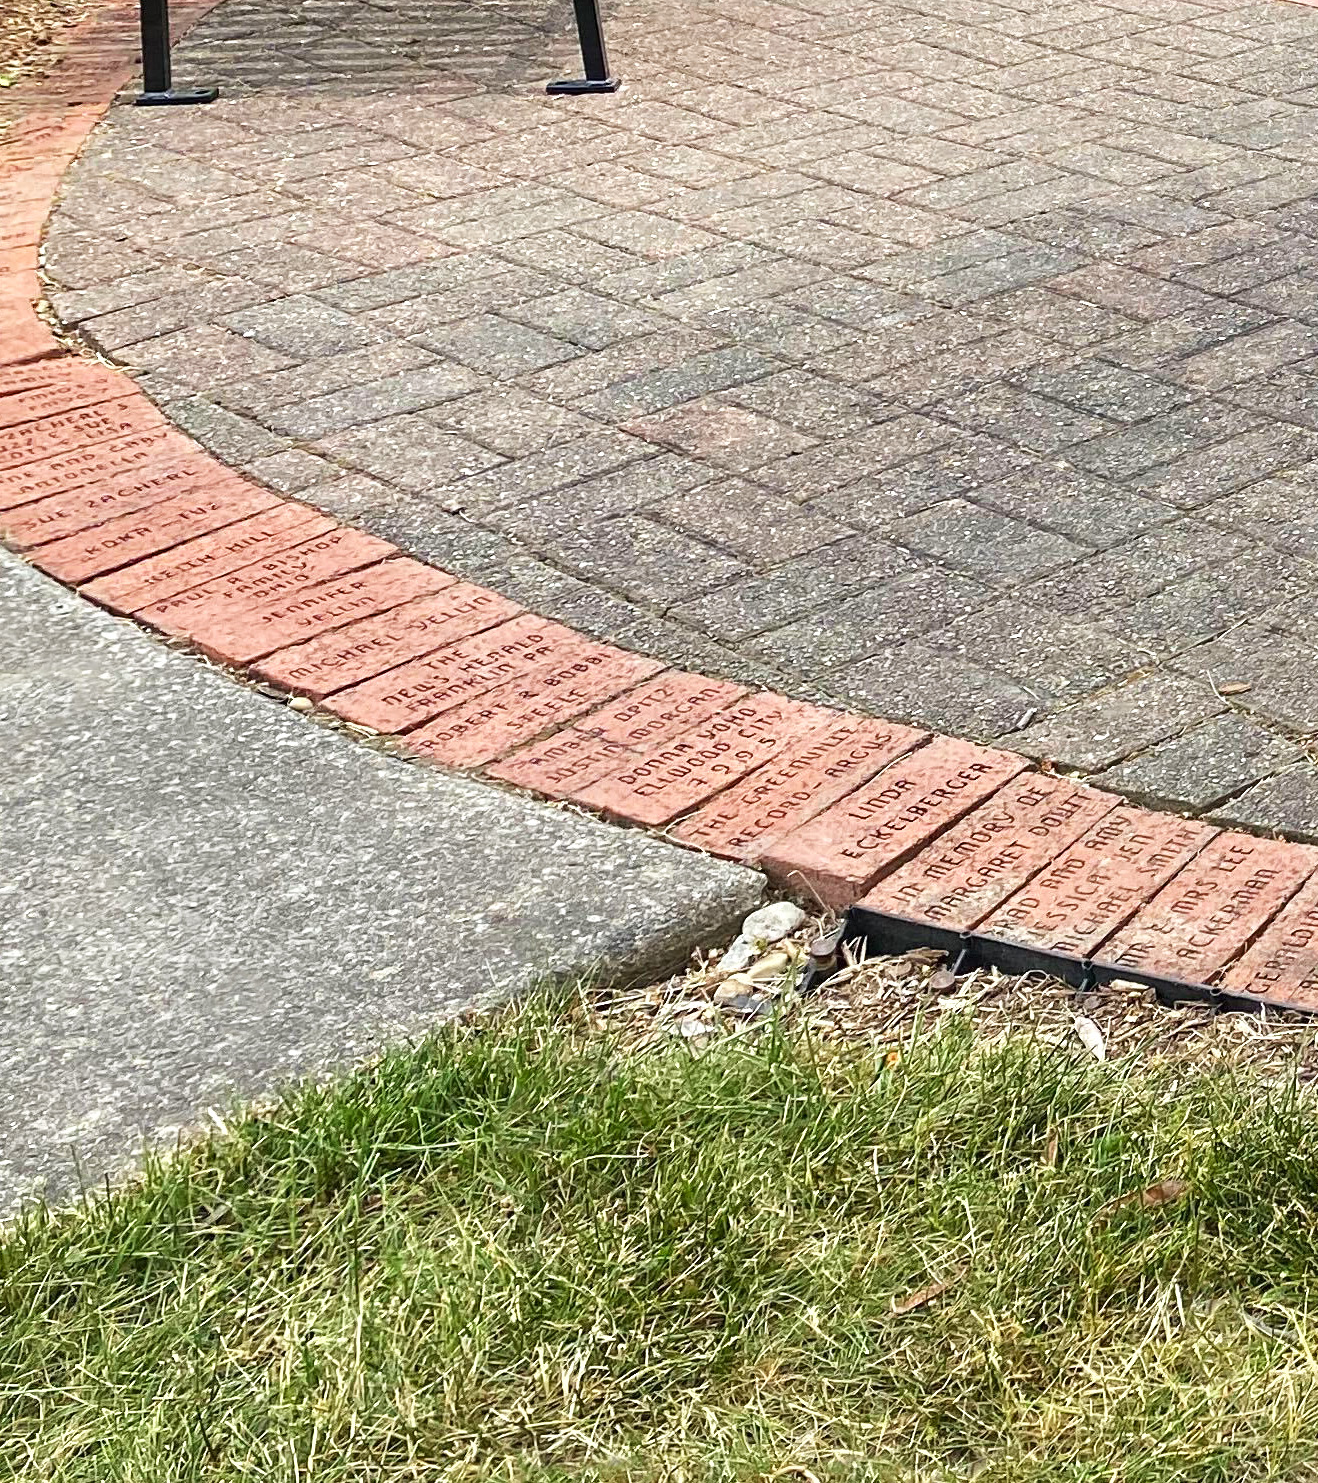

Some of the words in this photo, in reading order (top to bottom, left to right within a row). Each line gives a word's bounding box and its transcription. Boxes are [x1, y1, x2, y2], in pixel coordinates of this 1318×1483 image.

[156, 587, 218, 614] PAUL
[261, 535, 343, 572] BISHOP
[226, 530, 275, 554] HILL
[222, 560, 309, 600] FAMILY
[261, 581, 368, 623] JENNIFER
[297, 595, 376, 627] YELLIN
[288, 633, 402, 679] MICHAEL
[408, 595, 492, 631] YELLIN
[380, 674, 451, 706] NEWS
[461, 633, 545, 672] HERALD
[422, 648, 470, 670] THE
[405, 662, 514, 711] FRANKLIN
[523, 644, 555, 664] PA
[419, 701, 510, 750] ROBERT
[542, 652, 613, 687] BOBBI
[506, 687, 589, 729] STEELE
[545, 743, 622, 784] JUSTIN
[628, 687, 722, 740] MORGAN
[617, 742, 695, 786] DONNA
[697, 707, 757, 740] YOHO
[633, 741, 732, 798] ELLWOOD
[738, 710, 784, 739] CITY
[694, 809, 740, 838] THE
[740, 726, 859, 806] GREENVILLE
[839, 762, 993, 860] ECKELBERGER
[848, 778, 917, 820] LINDA
[891, 882, 926, 904] IN
[923, 809, 1015, 880] MEMORY
[923, 839, 1031, 922] MARGARET
[1039, 858, 1086, 889] AND
[1113, 834, 1155, 863] JEN
[1137, 826, 1200, 877] SMITH
[1170, 879, 1219, 915] MRS
[1216, 845, 1255, 873] LEE
[1175, 868, 1283, 960] ACKERMAN
